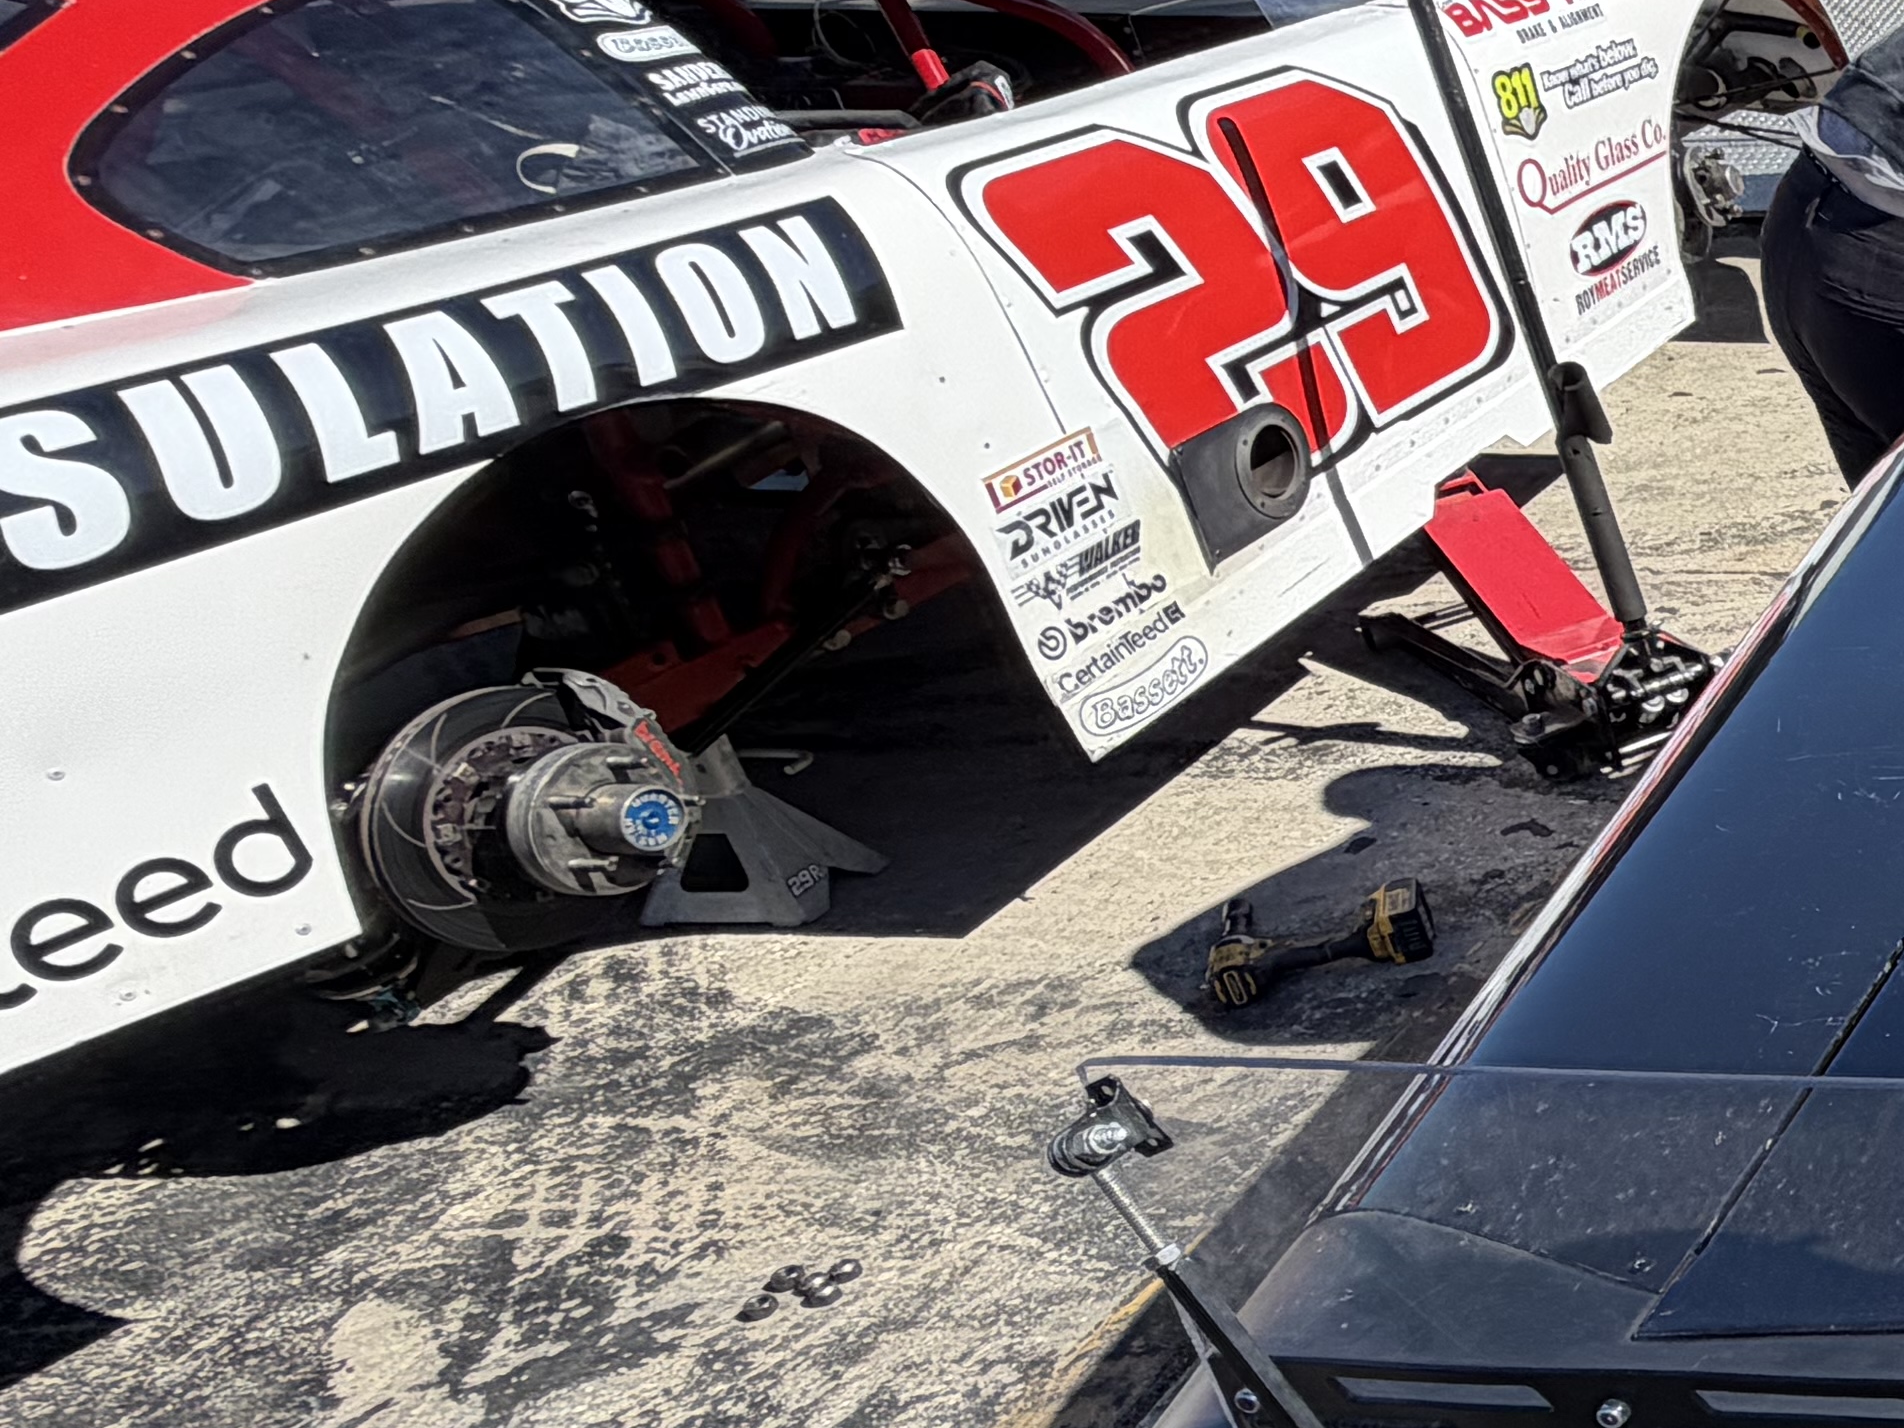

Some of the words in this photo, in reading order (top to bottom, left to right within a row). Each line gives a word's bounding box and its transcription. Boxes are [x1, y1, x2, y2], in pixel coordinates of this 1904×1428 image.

[1494, 65, 1540, 120] 811
[1563, 75, 1592, 110] Call
[1517, 148, 1591, 208] Quality
[1594, 136, 1640, 172] Glass
[1641, 119, 1667, 149] Co.
[955, 69, 1510, 462] 29
[1571, 203, 1646, 275] RMS
[0, 215, 858, 571] SULATION
[1023, 440, 1087, 487] STOR-IT
[996, 469, 1120, 561] DRIVEN
[1064, 573, 1168, 646] brembo
[1057, 611, 1171, 694] CertainTeed
[1091, 644, 1198, 730] Bassett
[0, 782, 314, 1010] eed
